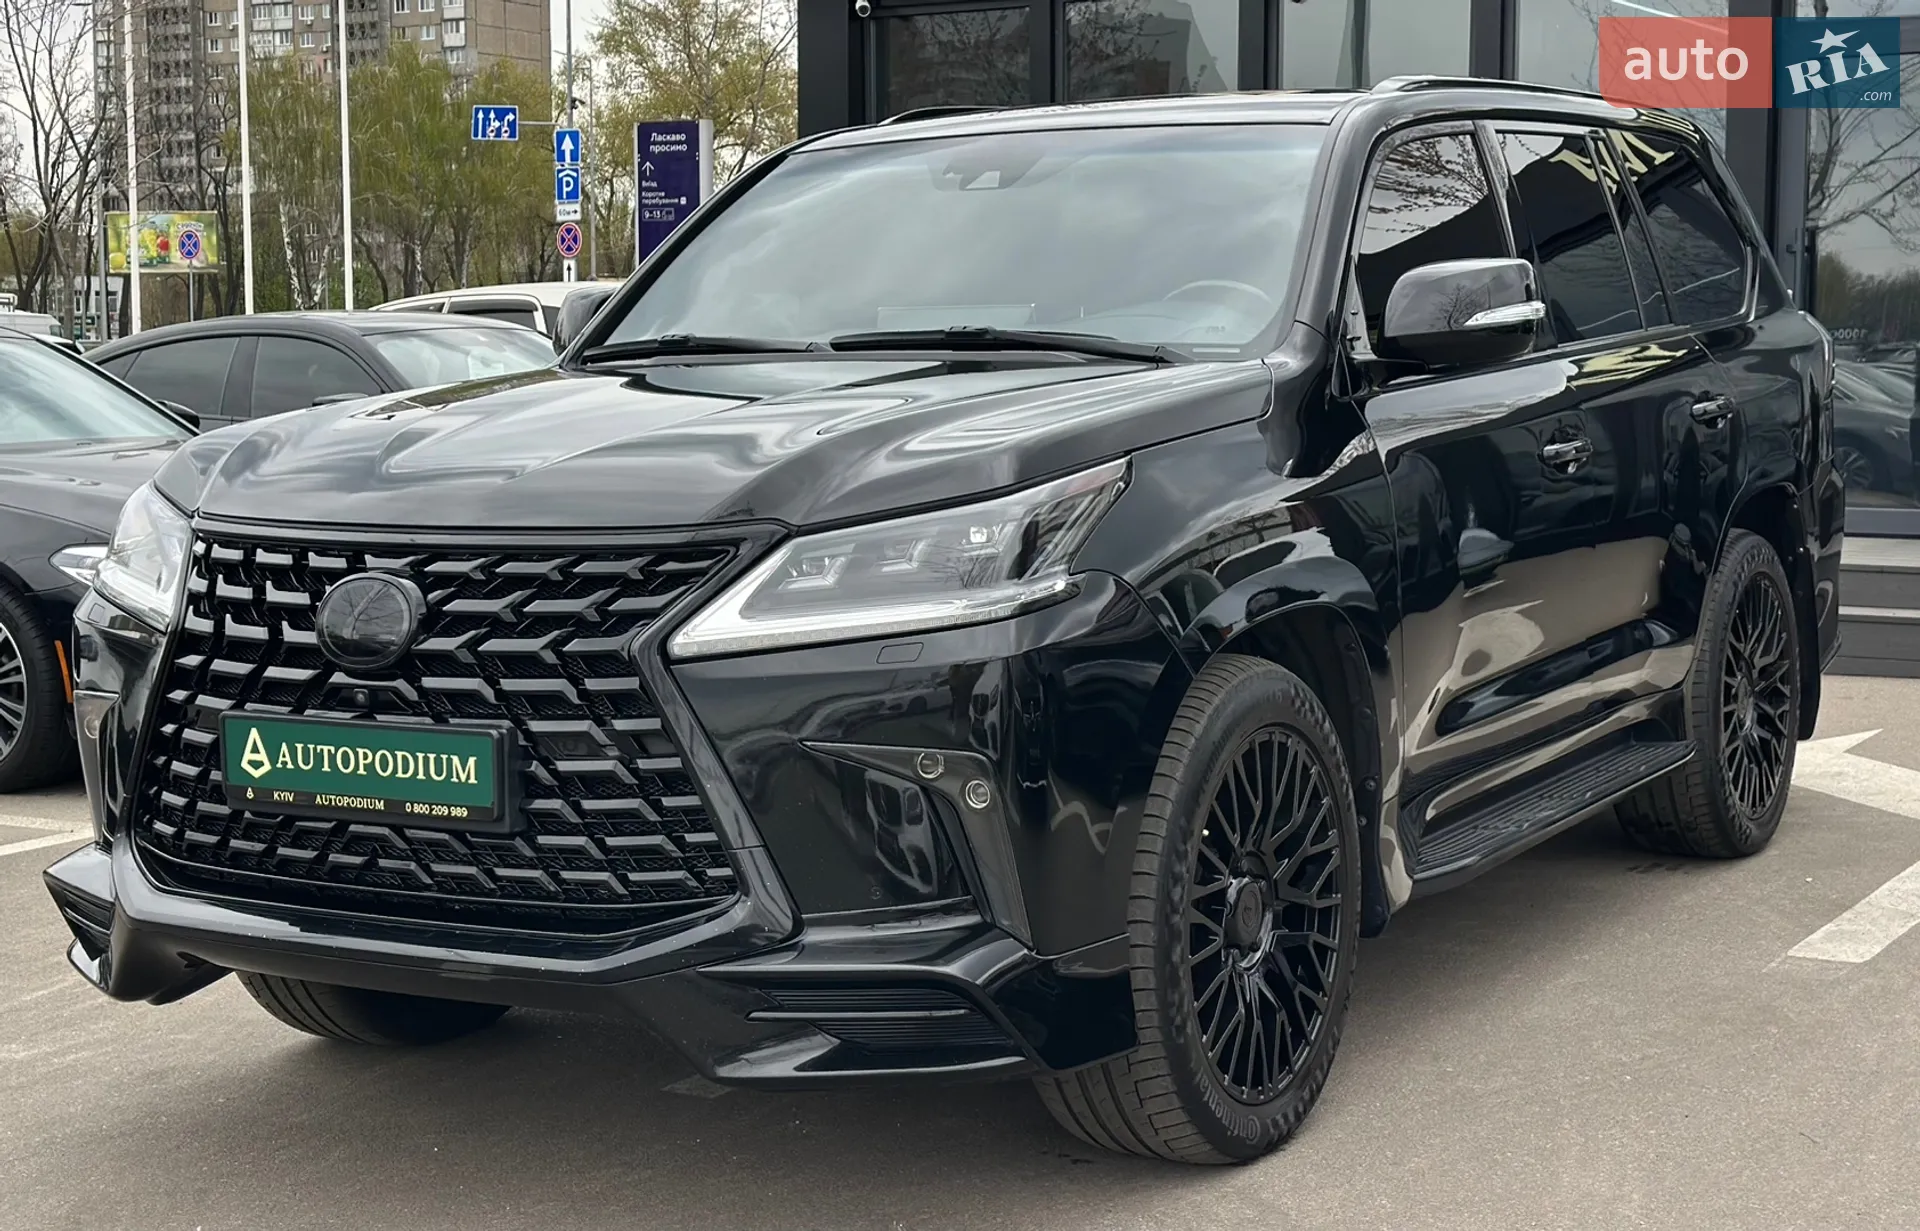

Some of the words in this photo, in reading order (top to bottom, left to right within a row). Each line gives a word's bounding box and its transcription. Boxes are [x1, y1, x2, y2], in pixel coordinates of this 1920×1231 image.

[650, 132, 686, 141] Ласкаво
[649, 144, 688, 154] просимо
[562, 176, 574, 199] P
[275, 741, 478, 784] AUTOPODIUM
[272, 790, 294, 802] KYIV
[315, 794, 384, 810] AUTOPODIUM
[405, 803, 412, 812] 0
[413, 803, 430, 814] 800
[431, 805, 449, 816] 209
[450, 806, 468, 817] 989
